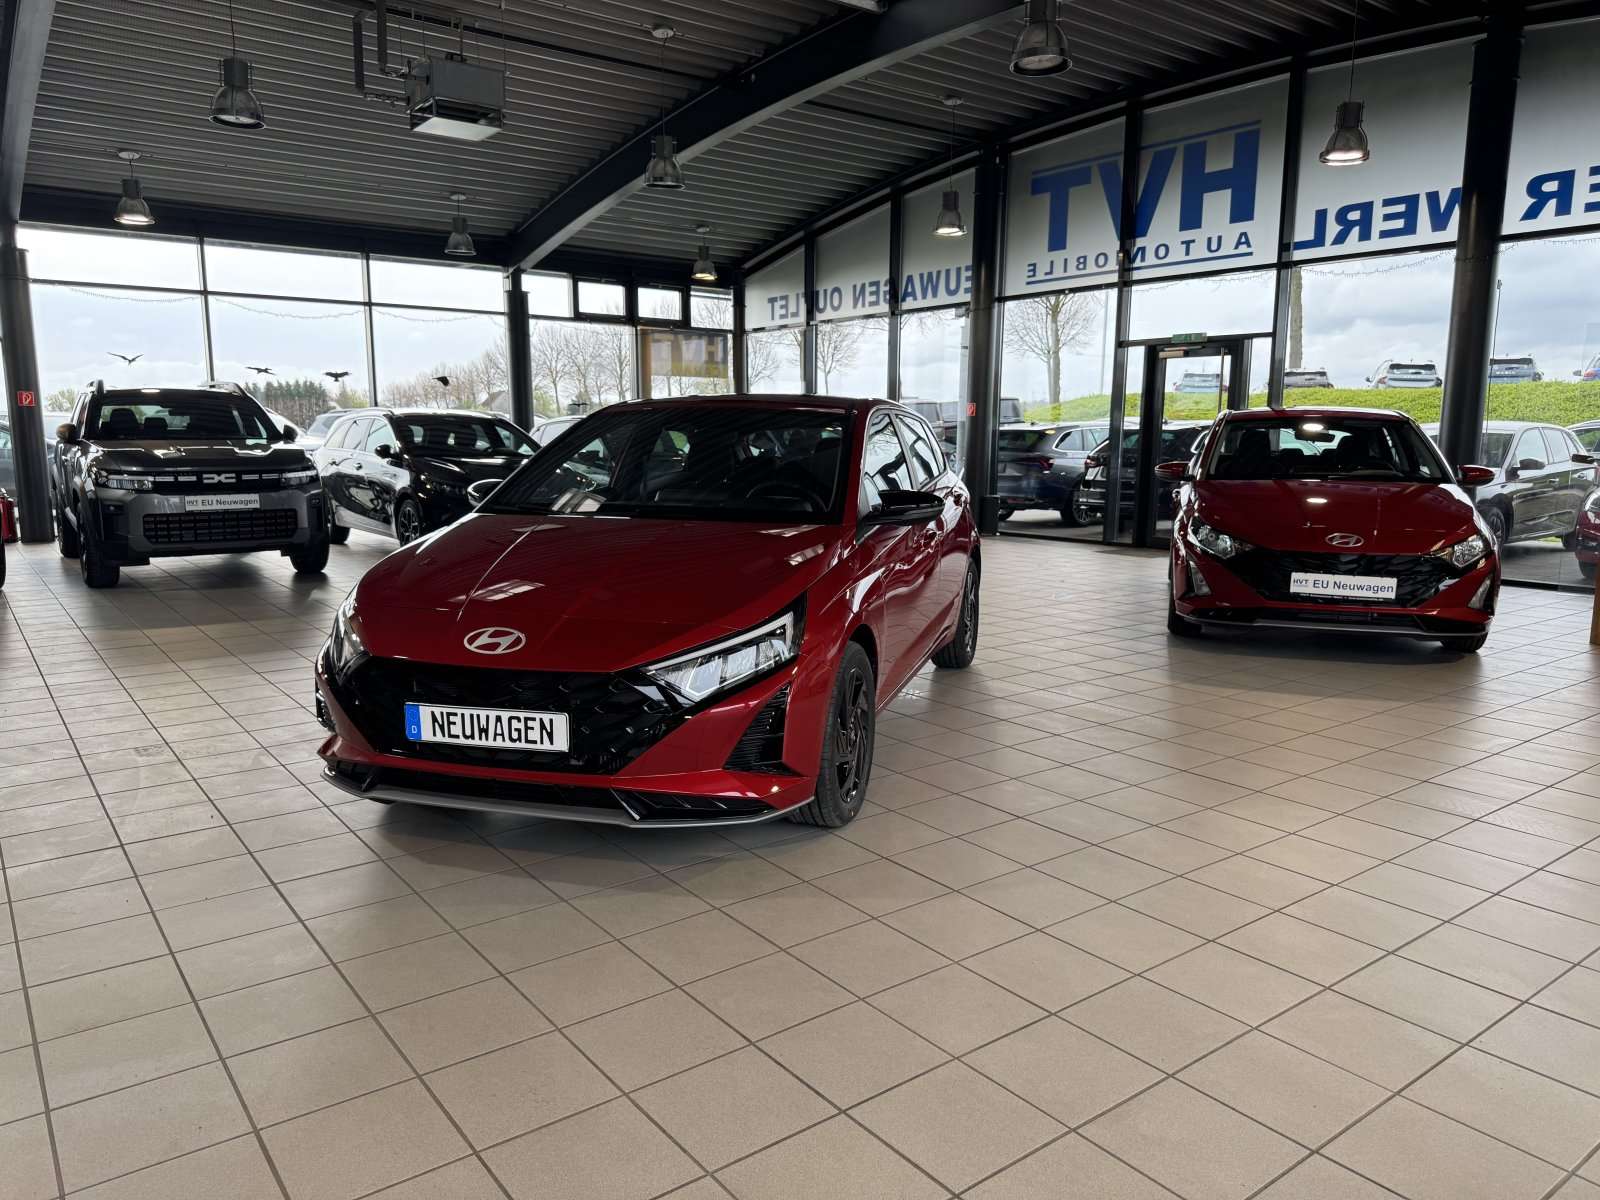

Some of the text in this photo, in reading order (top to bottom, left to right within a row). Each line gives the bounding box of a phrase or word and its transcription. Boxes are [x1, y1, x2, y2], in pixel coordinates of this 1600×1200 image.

[216, 498, 258, 507] Neuwagen
[1313, 579, 1329, 589] EU
[1333, 581, 1394, 594] Neuwagen
[411, 711, 554, 746] D NEUWAGEN
